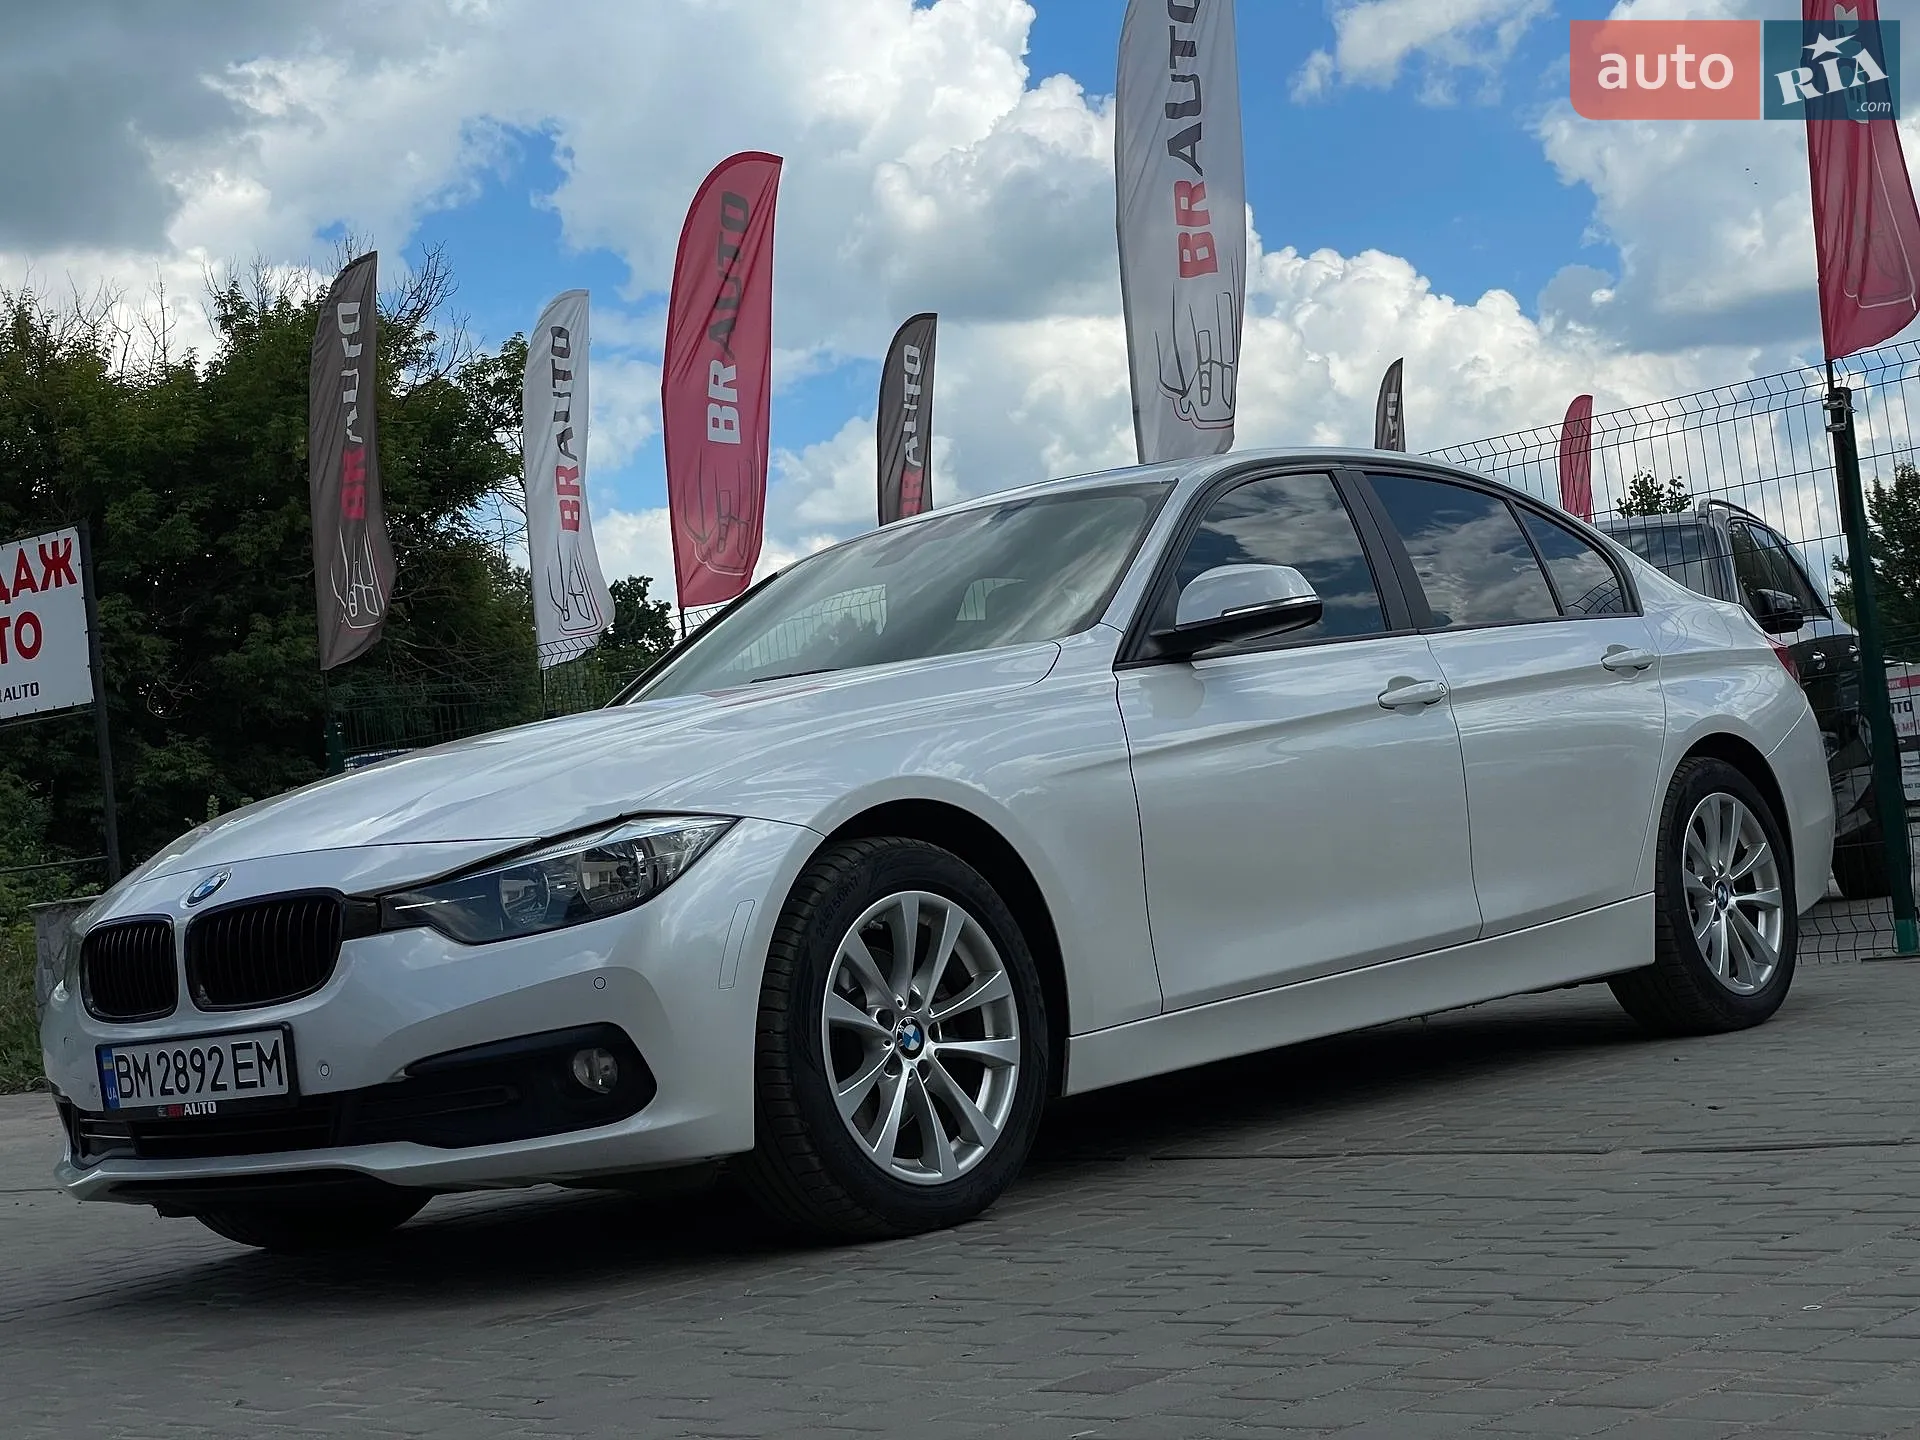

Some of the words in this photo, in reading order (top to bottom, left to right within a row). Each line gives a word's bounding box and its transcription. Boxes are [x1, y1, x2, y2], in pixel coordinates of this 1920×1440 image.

[708, 191, 750, 444] BRAUTO
[550, 325, 581, 533] BRAUTO
[106, 1087, 118, 1100] UA
[115, 1052, 154, 1098] BM
[157, 1046, 228, 1094] 2892
[231, 1039, 283, 1090] EM
